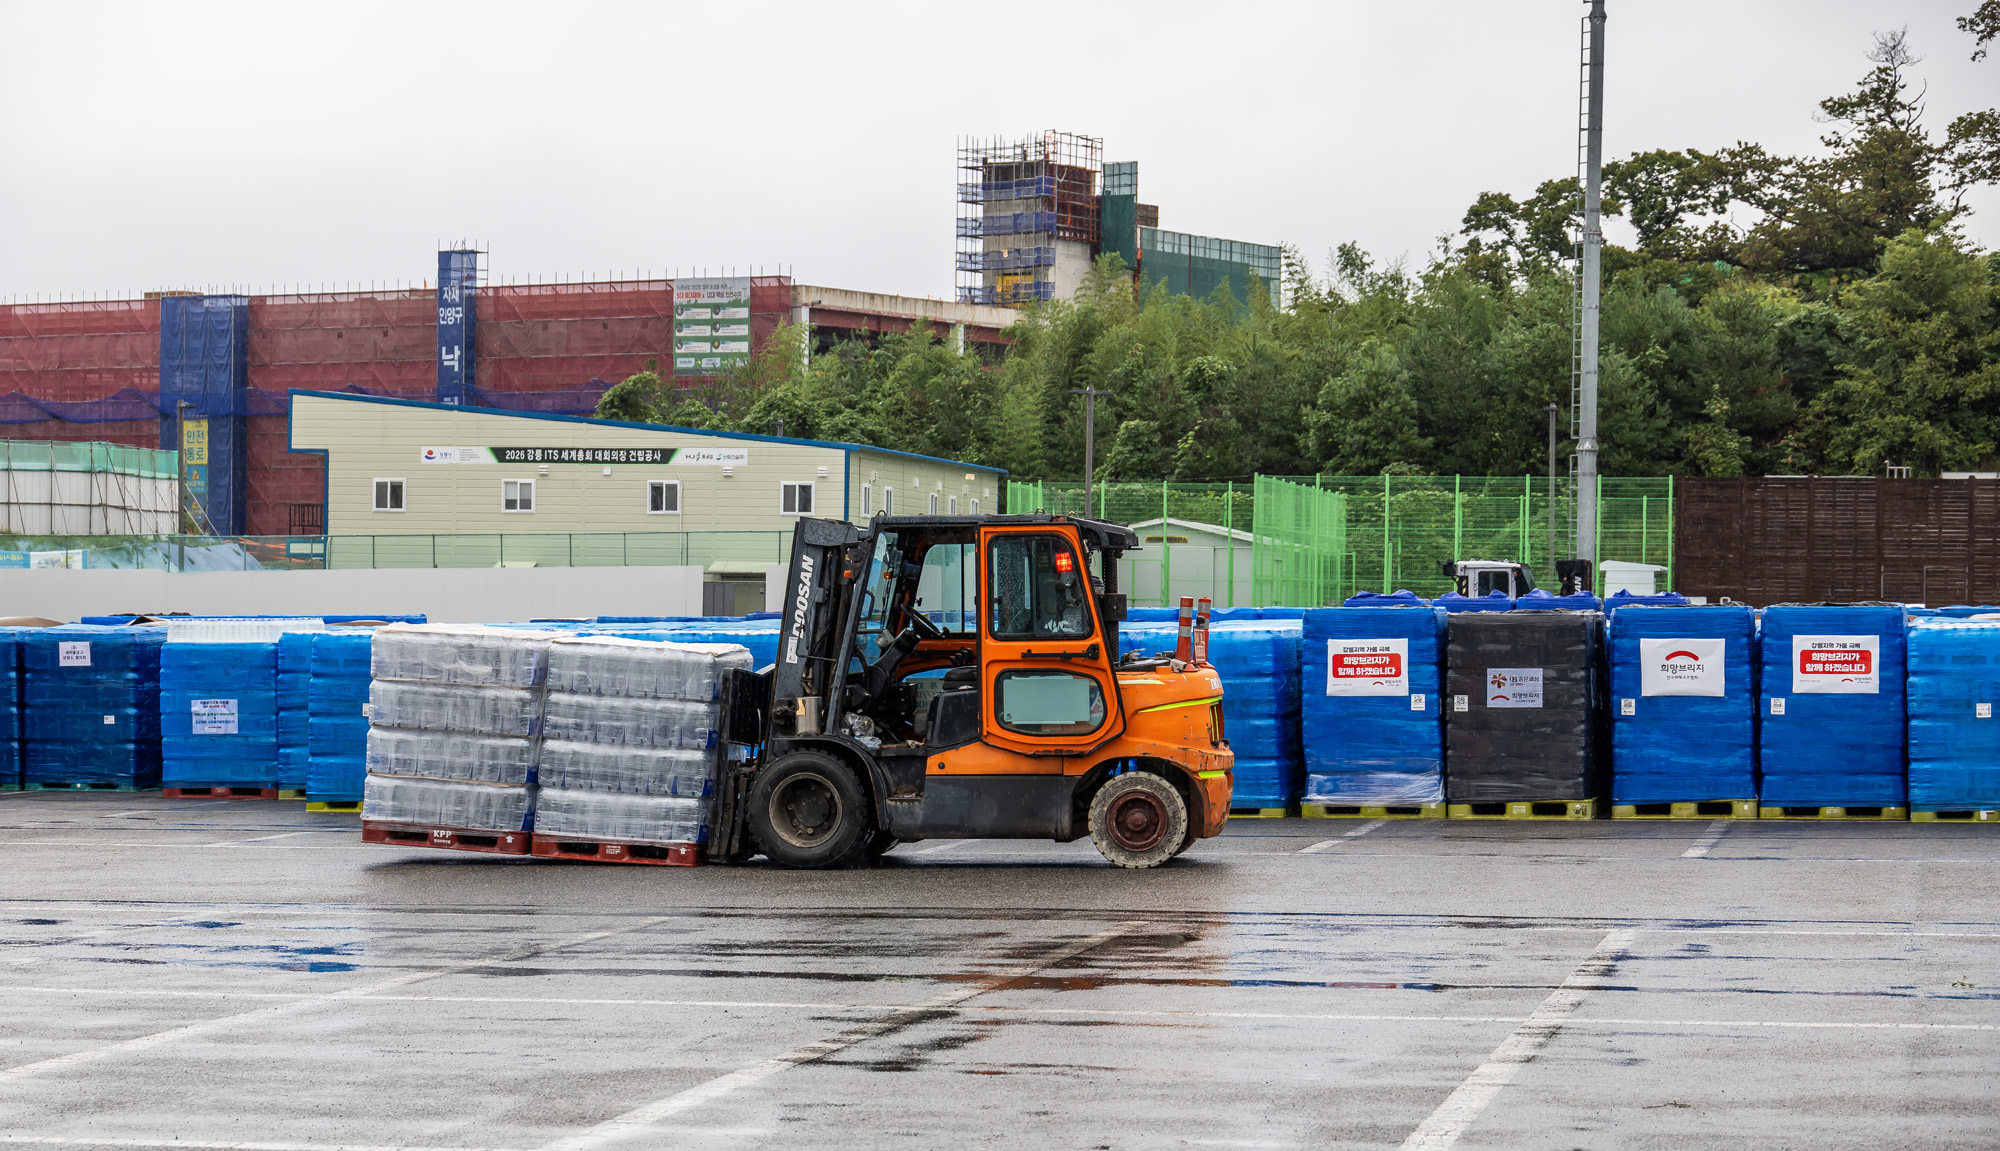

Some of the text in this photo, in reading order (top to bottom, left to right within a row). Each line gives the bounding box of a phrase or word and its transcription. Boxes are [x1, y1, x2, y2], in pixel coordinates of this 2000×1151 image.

[443, 285, 459, 303] 자재
[439, 306, 462, 325] 인양구
[186, 429, 204, 444] 안전
[186, 447, 204, 461] 통로
[505, 449, 661, 461] 2026 강릉 ITS 세계총회 대회의장 건립공사
[1574, 575, 1582, 594] AN
[792, 555, 814, 639] DOOSAN
[1343, 656, 1390, 665] 희망브리지가
[1811, 652, 1860, 661] 희망브리지가
[1338, 666, 1396, 676] 함께 하겠습니다
[1660, 664, 1704, 674] 희망브리지
[1805, 663, 1866, 672] 함께 하겠습니다
[433, 830, 451, 838] KPP
